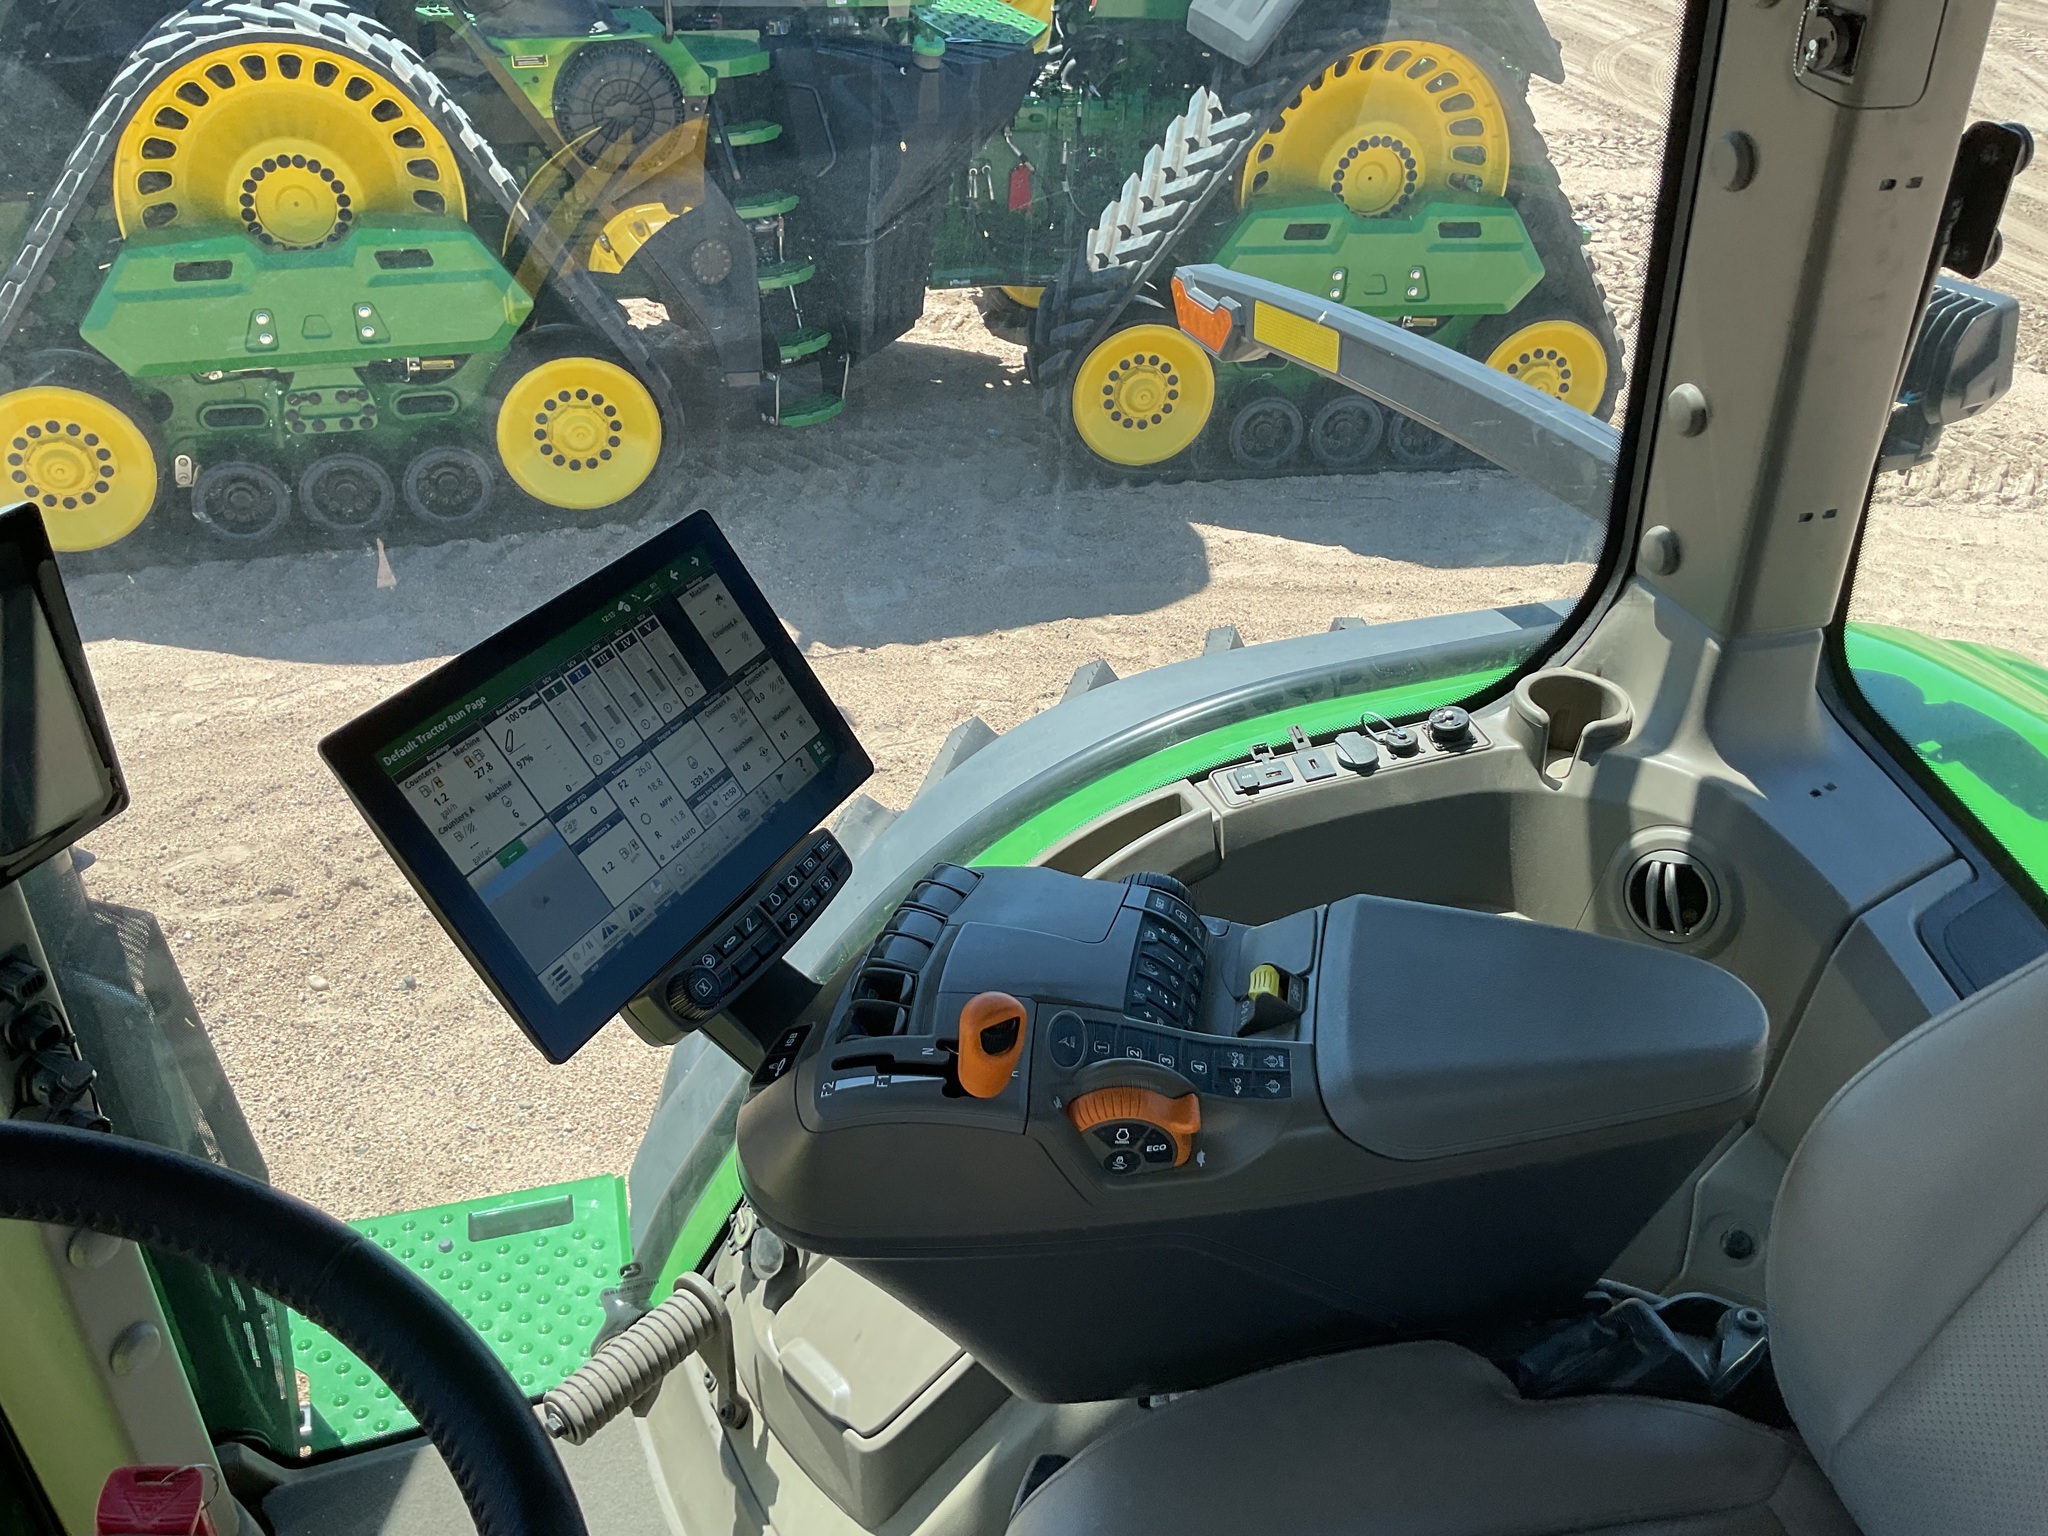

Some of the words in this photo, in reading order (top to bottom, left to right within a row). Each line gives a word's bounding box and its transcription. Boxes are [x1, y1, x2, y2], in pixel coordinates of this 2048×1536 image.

[600, 610, 616, 623] 12:13
[636, 613, 646, 622] SCV
[614, 628, 624, 637] SCV
[644, 622, 653, 632] V
[590, 643, 601, 652] SCV
[620, 636, 632, 648] IV
[566, 659, 577, 668] SCV
[596, 652, 610, 664] III
[541, 675, 552, 685] SCV
[574, 669, 584, 679] II
[743, 667, 766, 688] Counters
[753, 691, 765, 704] 0.0
[494, 704, 508, 716] Rear
[506, 696, 521, 708] Hitch
[703, 697, 726, 718] Counters
[771, 703, 791, 722] Machine
[503, 710, 520, 725] 100
[381, 738, 419, 766] Default
[415, 719, 450, 744] Tractor
[446, 707, 467, 724] Run
[464, 694, 489, 714] Page
[779, 729, 789, 740] 81
[452, 735, 481, 757] Machine
[732, 734, 754, 754] Machine
[514, 752, 534, 770] 97%
[634, 760, 652, 777] 26.0
[741, 761, 751, 773] 48
[403, 765, 436, 790] Counters
[434, 761, 443, 769] A
[472, 760, 494, 779] 27.8
[690, 769, 710, 789] 339.5
[707, 765, 715, 774] h
[483, 778, 513, 802] Machine
[564, 783, 573, 793] 0
[616, 778, 629, 791] F2
[646, 776, 664, 793] 18.8
[696, 792, 706, 802] Max
[704, 786, 714, 796] Eng
[711, 776, 724, 790] Speed
[432, 791, 450, 807] 1.2
[722, 785, 737, 801] 2150
[628, 795, 640, 807] F1
[658, 794, 673, 809] MPH
[438, 801, 459, 820] gal/h
[510, 808, 520, 819] 6
[589, 805, 598, 815] 0
[670, 809, 686, 826] 11.8
[436, 810, 469, 836] Counters
[467, 805, 476, 814] A
[586, 825, 607, 844] Counters
[654, 829, 662, 839] R
[670, 838, 682, 851] Full
[680, 826, 696, 843] AUTO
[820, 840, 832, 852] ITEC
[470, 845, 493, 865] gal/ac
[600, 860, 615, 876] 1.2
[784, 1032, 798, 1046] ISB
[922, 1048, 934, 1056] N
[821, 1080, 835, 1098] F2
[876, 1075, 889, 1088] F1
[1146, 1144, 1166, 1152] ECO
